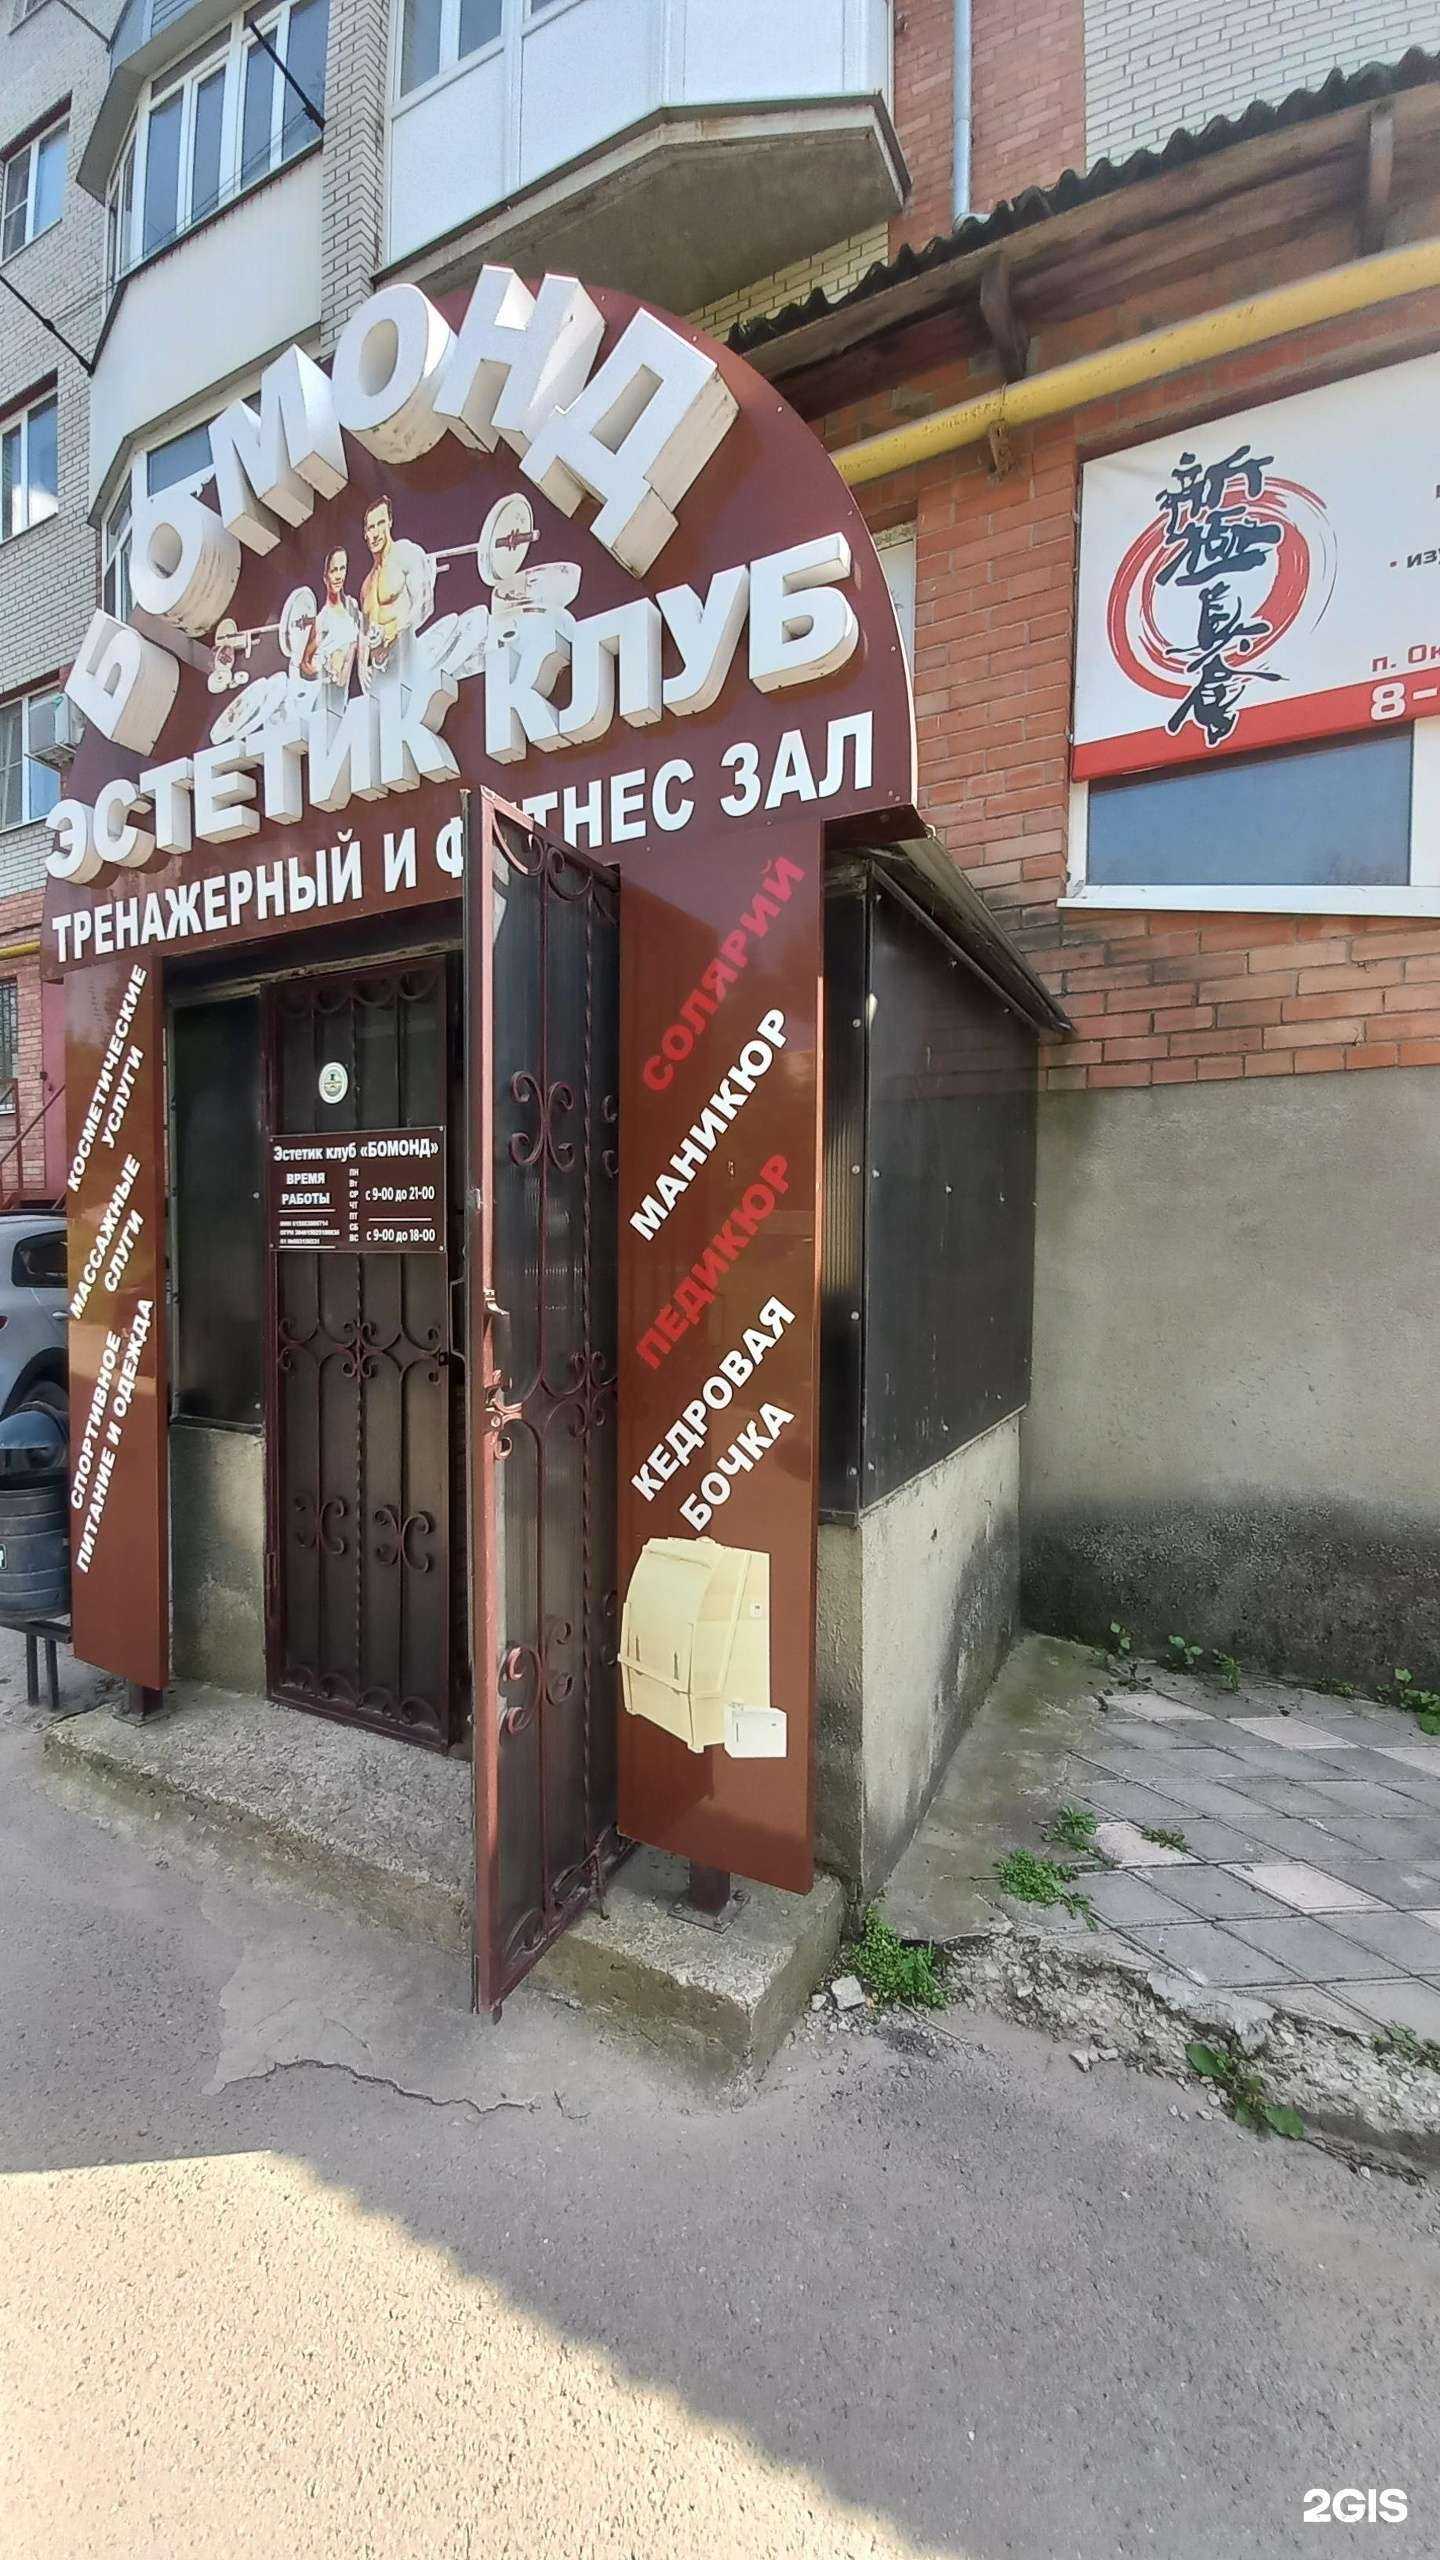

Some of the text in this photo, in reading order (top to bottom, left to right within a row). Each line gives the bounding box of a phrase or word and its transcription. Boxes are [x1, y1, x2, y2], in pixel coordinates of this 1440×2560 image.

[65, 264, 737, 755] БОМОНД
[1407, 547, 1440, 568] ИЗ
[45, 532, 859, 885] ЭСТЕТИК КЛУБ
[52, 710, 874, 963] ТРЕНАЖЕРНЫЙ И ФТНЕС ЗАЛ
[642, 856, 805, 1093] СОЛЯРИЙ
[68, 964, 147, 1192] КОСМЕТИЧЕСКИЕ
[101, 1045, 144, 1149] УСЛУГИ
[274, 1138, 439, 1162] Эстетик клуб «БОМОНД»
[629, 1008, 789, 1241] МАНИКЮР
[70, 1154, 141, 1319] МАССАЖНЫЕ
[104, 1209, 144, 1292] СЛУГИ
[282, 1193, 330, 1205] РАБОТЫ
[286, 1172, 326, 1184] ВРЕМЯ
[372, 1187, 394, 1200] 9-00
[395, 1190, 408, 1202] до
[409, 1186, 435, 1200] 21-00
[373, 1229, 395, 1242] 9-00
[396, 1232, 408, 1243] до
[410, 1229, 436, 1241] 18-00
[636, 1153, 794, 1370] ПЕДИКЮР
[71, 1330, 121, 1509] СПОРТИВНОЕ
[76, 1300, 153, 1573] ПИТАНИЕ И ОДЕЖДА
[631, 1296, 796, 1502] КЕДРОВАЯ
[679, 1402, 795, 1531] БОЧКА
